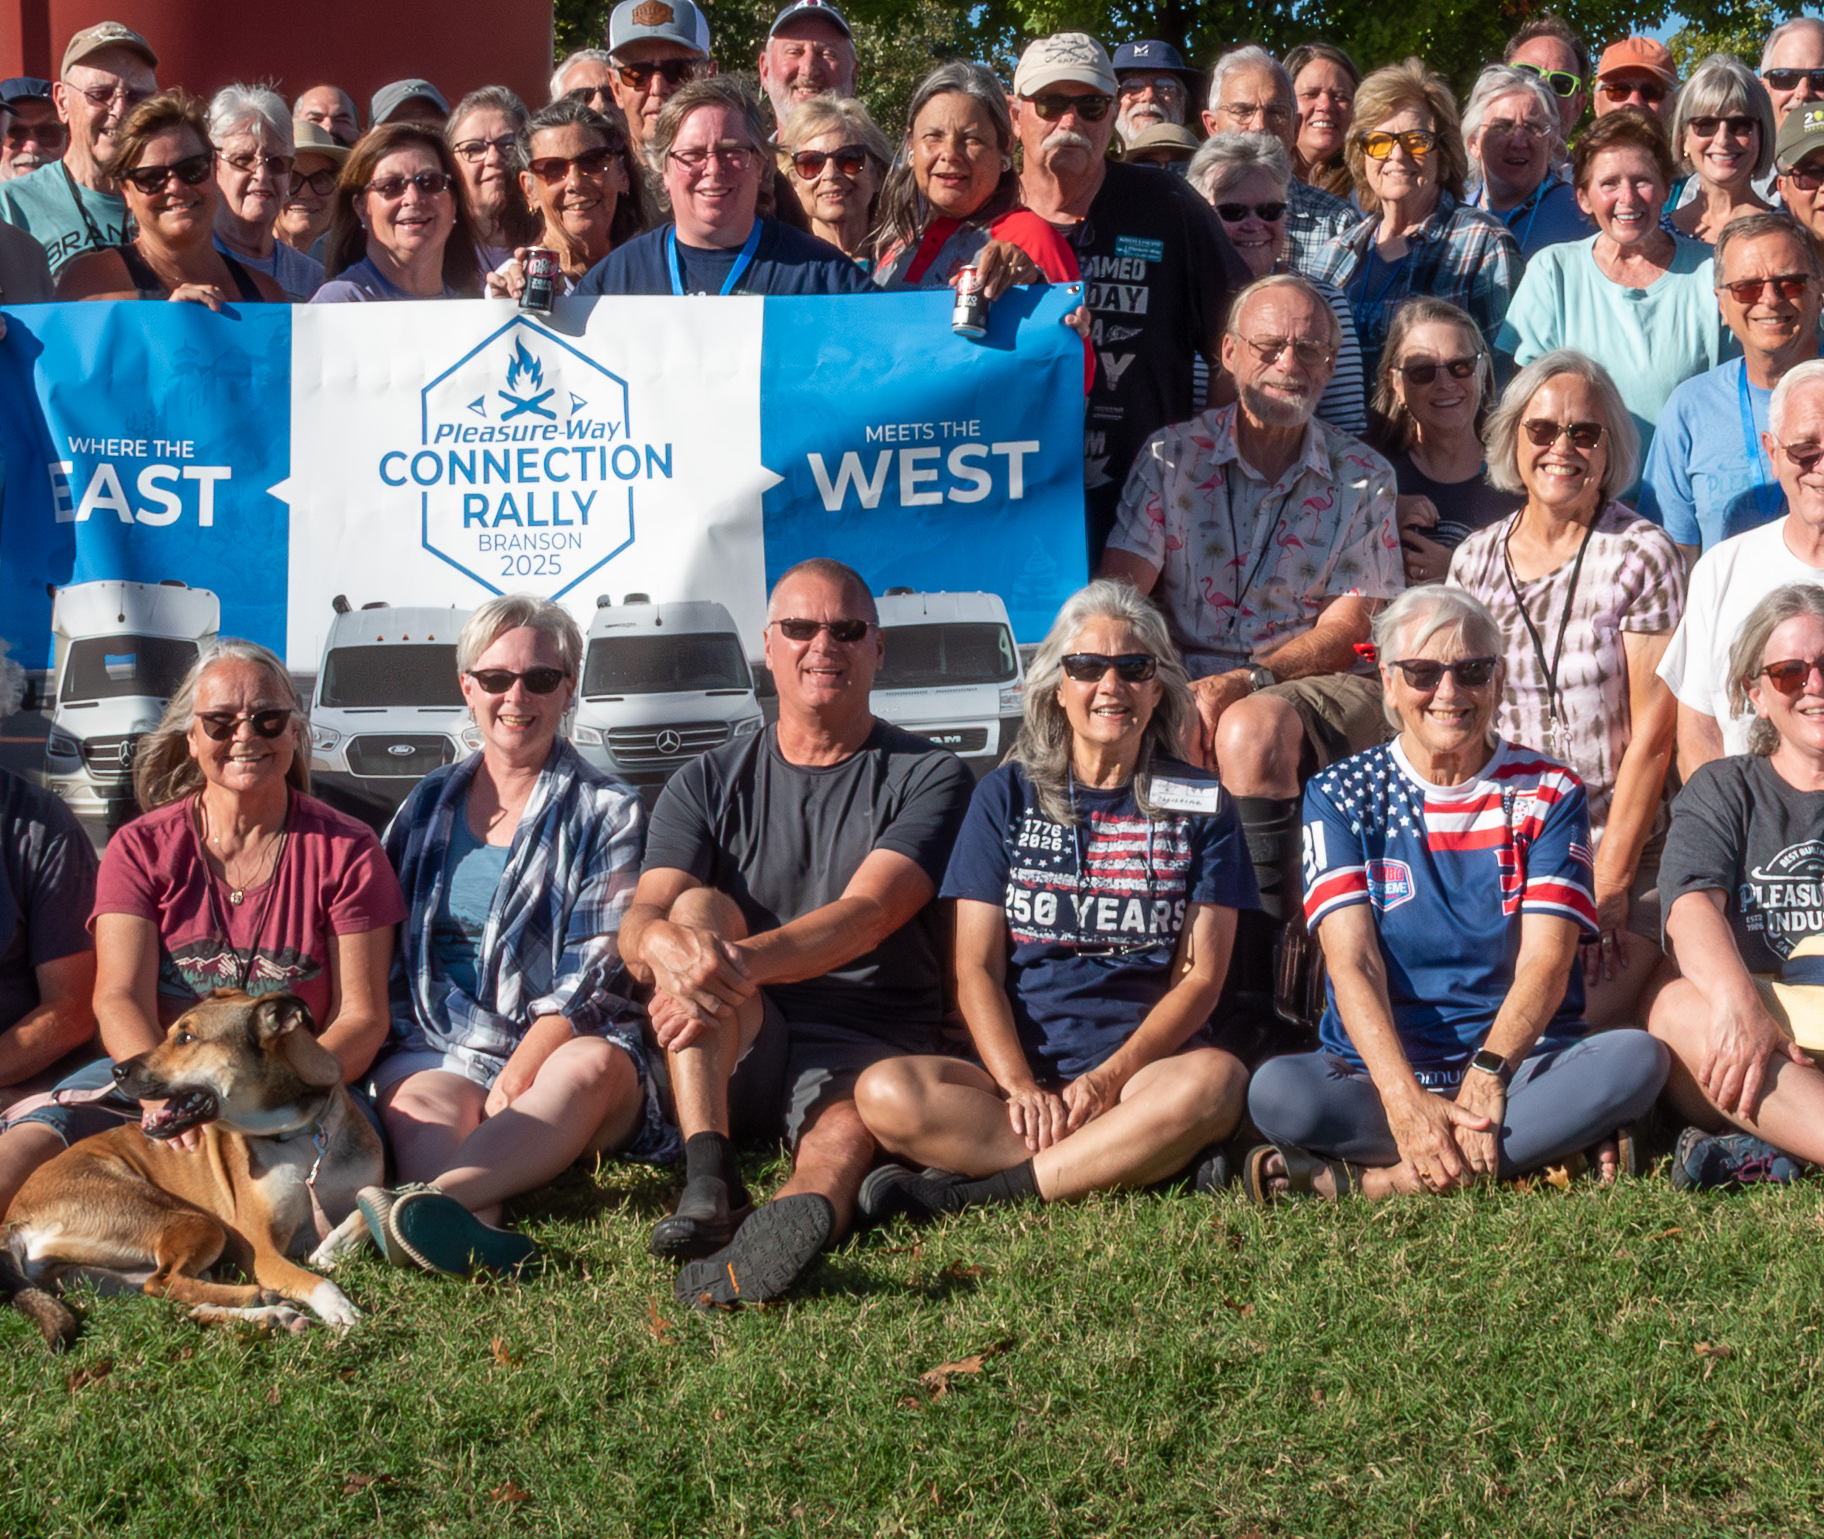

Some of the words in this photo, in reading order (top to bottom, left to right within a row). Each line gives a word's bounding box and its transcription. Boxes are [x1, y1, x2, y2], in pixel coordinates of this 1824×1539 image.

[433, 419, 622, 445] Pleasure-Way
[865, 422, 935, 444] MEETS
[939, 419, 981, 438] THE
[68, 436, 147, 458] WHERE
[153, 439, 195, 458] THE
[379, 443, 673, 487] CONNECTION
[807, 440, 1040, 512] WEST
[48, 461, 232, 527] EAST
[463, 490, 598, 529] RALLY
[478, 532, 582, 552] BRANSON
[500, 554, 562, 577] 2025
[1024, 819, 1063, 838] 1776
[1018, 833, 1063, 851] 2026
[1070, 893, 1187, 934] YEARS
